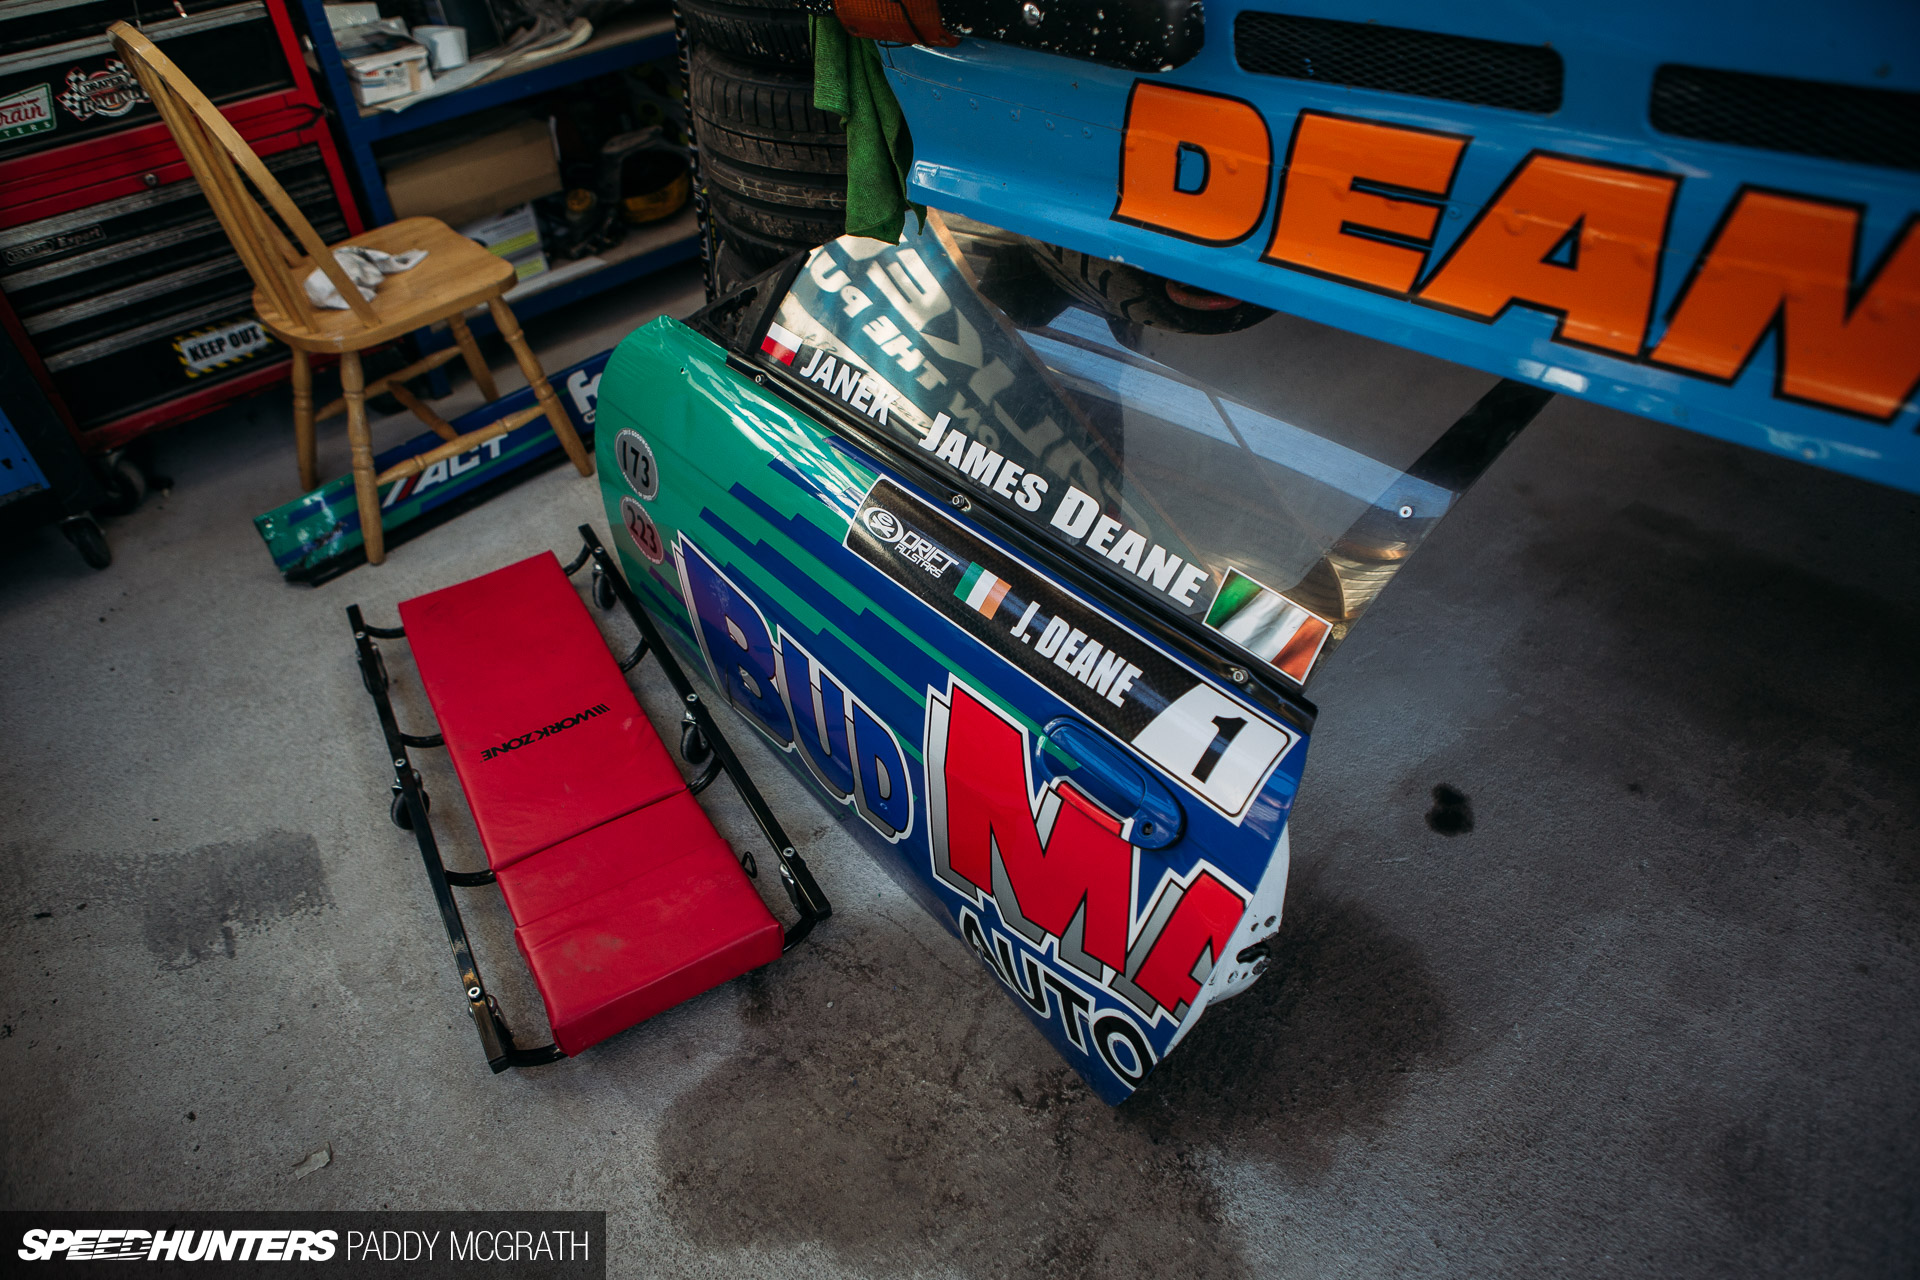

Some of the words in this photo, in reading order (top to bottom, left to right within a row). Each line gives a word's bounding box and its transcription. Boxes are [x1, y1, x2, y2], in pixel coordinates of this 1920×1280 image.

[2, 121, 52, 138] TERS
[1110, 79, 1920, 430] DEAN
[188, 336, 228, 363] KEEP
[230, 326, 261, 348] OUT
[799, 349, 902, 426] JANEK
[622, 440, 650, 488] 173
[626, 505, 657, 554] 223
[918, 412, 1049, 513] JAMES
[1051, 486, 1209, 608] DEANE
[894, 543, 944, 579] ALLSTARS
[899, 530, 959, 572] DRIFT
[674, 532, 914, 842] BUD
[1009, 600, 1041, 643] J.
[1034, 615, 1143, 708] DEANE
[1191, 714, 1248, 784] 1
[960, 905, 1157, 1091] AUTO
